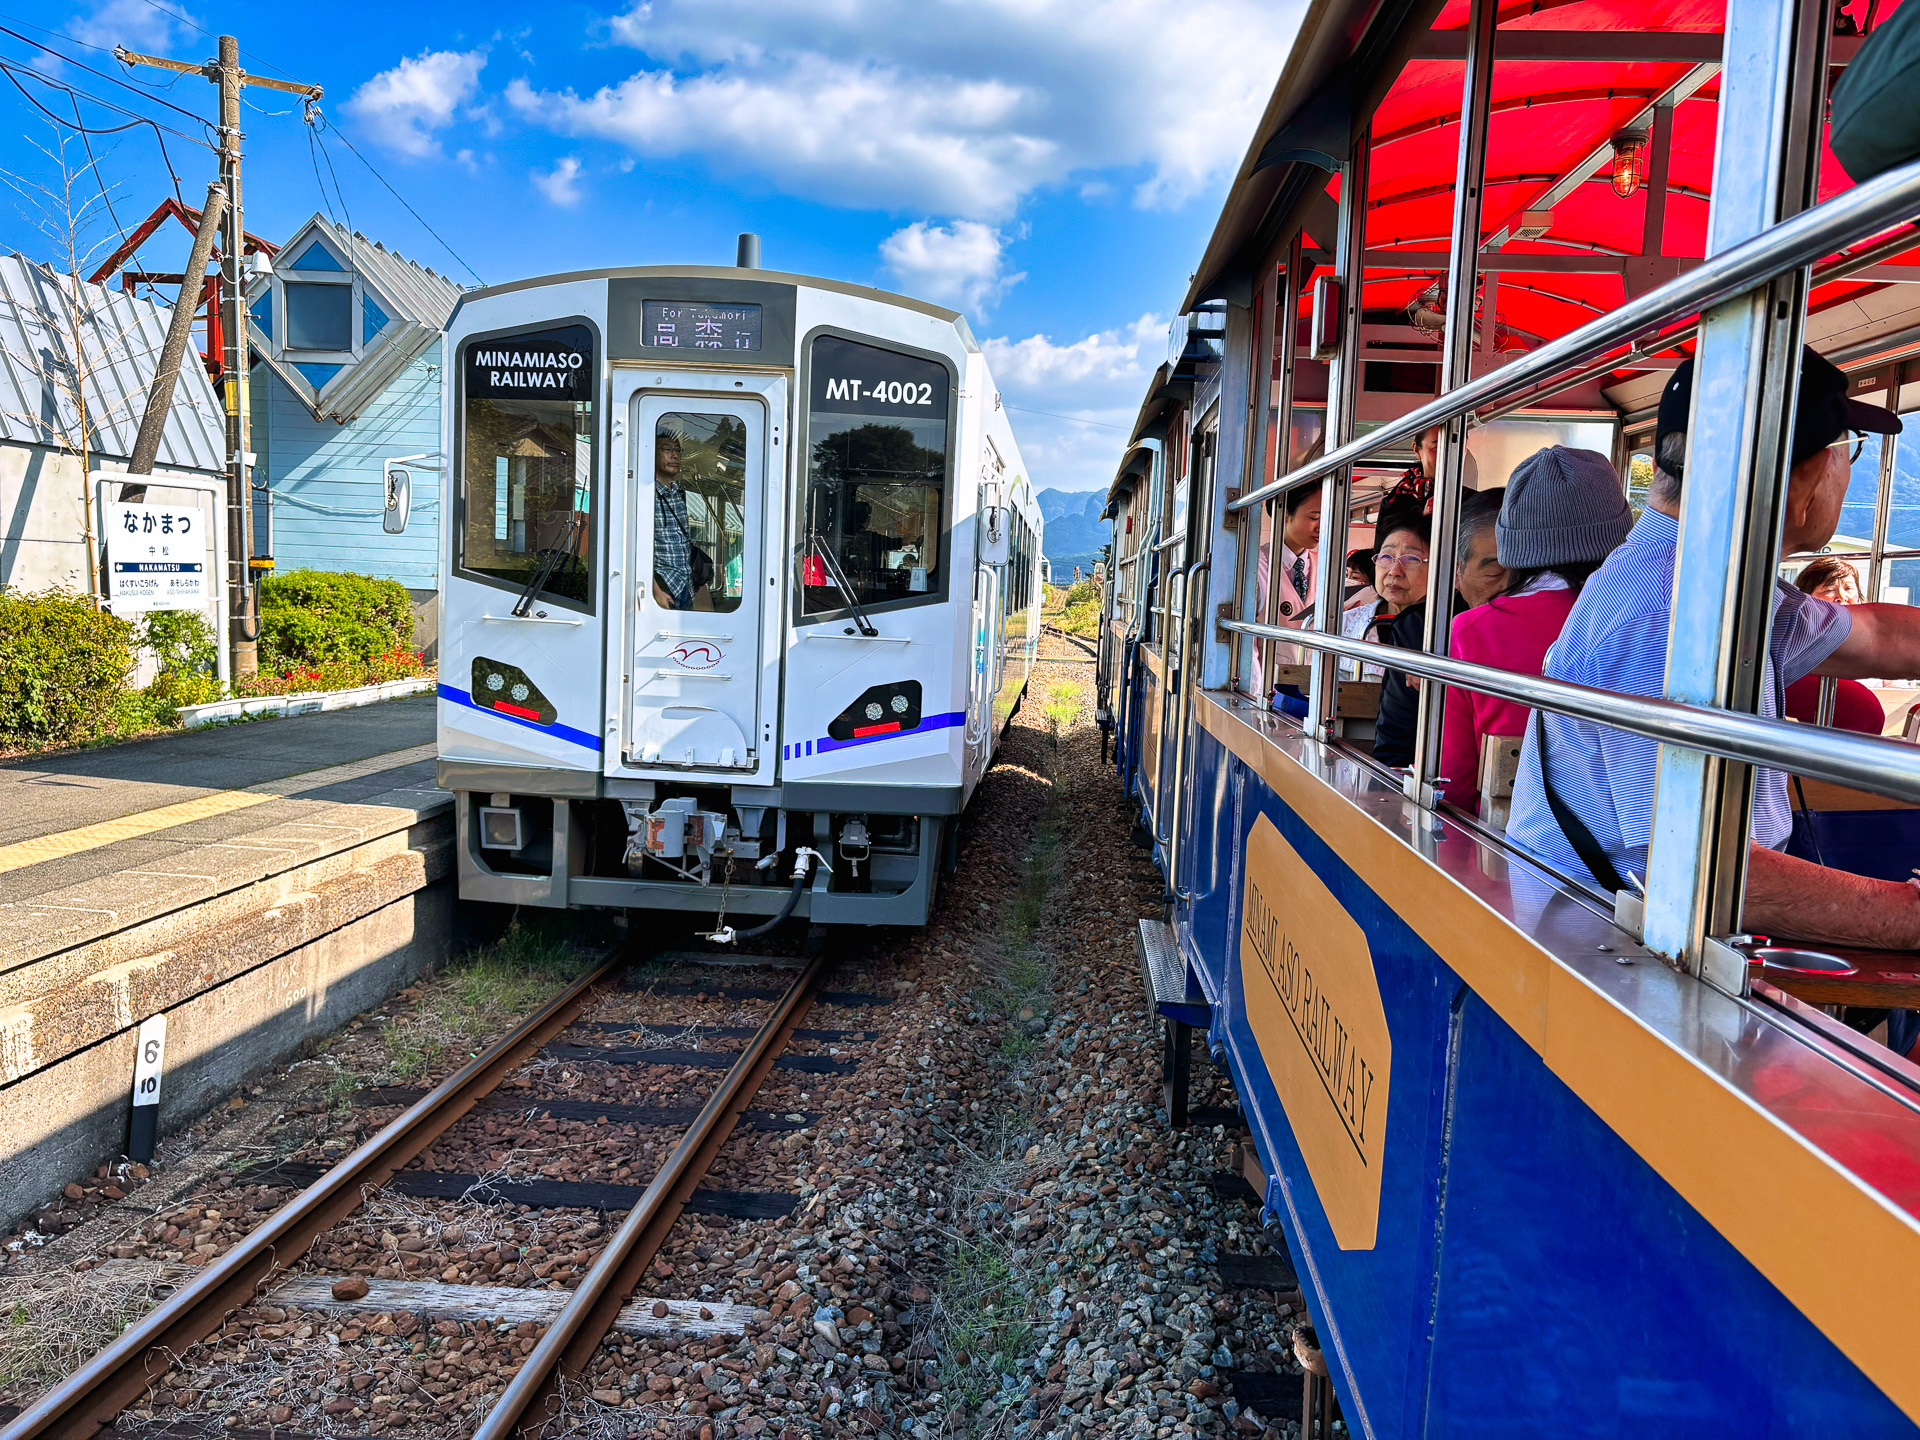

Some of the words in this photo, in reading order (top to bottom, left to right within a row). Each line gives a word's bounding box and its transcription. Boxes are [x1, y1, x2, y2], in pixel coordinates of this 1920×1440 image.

[662, 307, 683, 318] For
[475, 350, 583, 369] MINAMIASO
[490, 370, 568, 388] RAILWAY
[825, 378, 932, 405] MT-4002
[123, 510, 191, 535] なかまつ
[148, 545, 169, 556] 中松
[139, 563, 180, 571] NAKAMATSU
[119, 579, 159, 588] はくすいこうげん
[170, 579, 200, 587] あそしらかわ
[1277, 933, 1300, 1013] ASO
[1301, 968, 1374, 1144] RAILWAY
[144, 1039, 161, 1064] 6
[140, 1076, 157, 1094] 10
